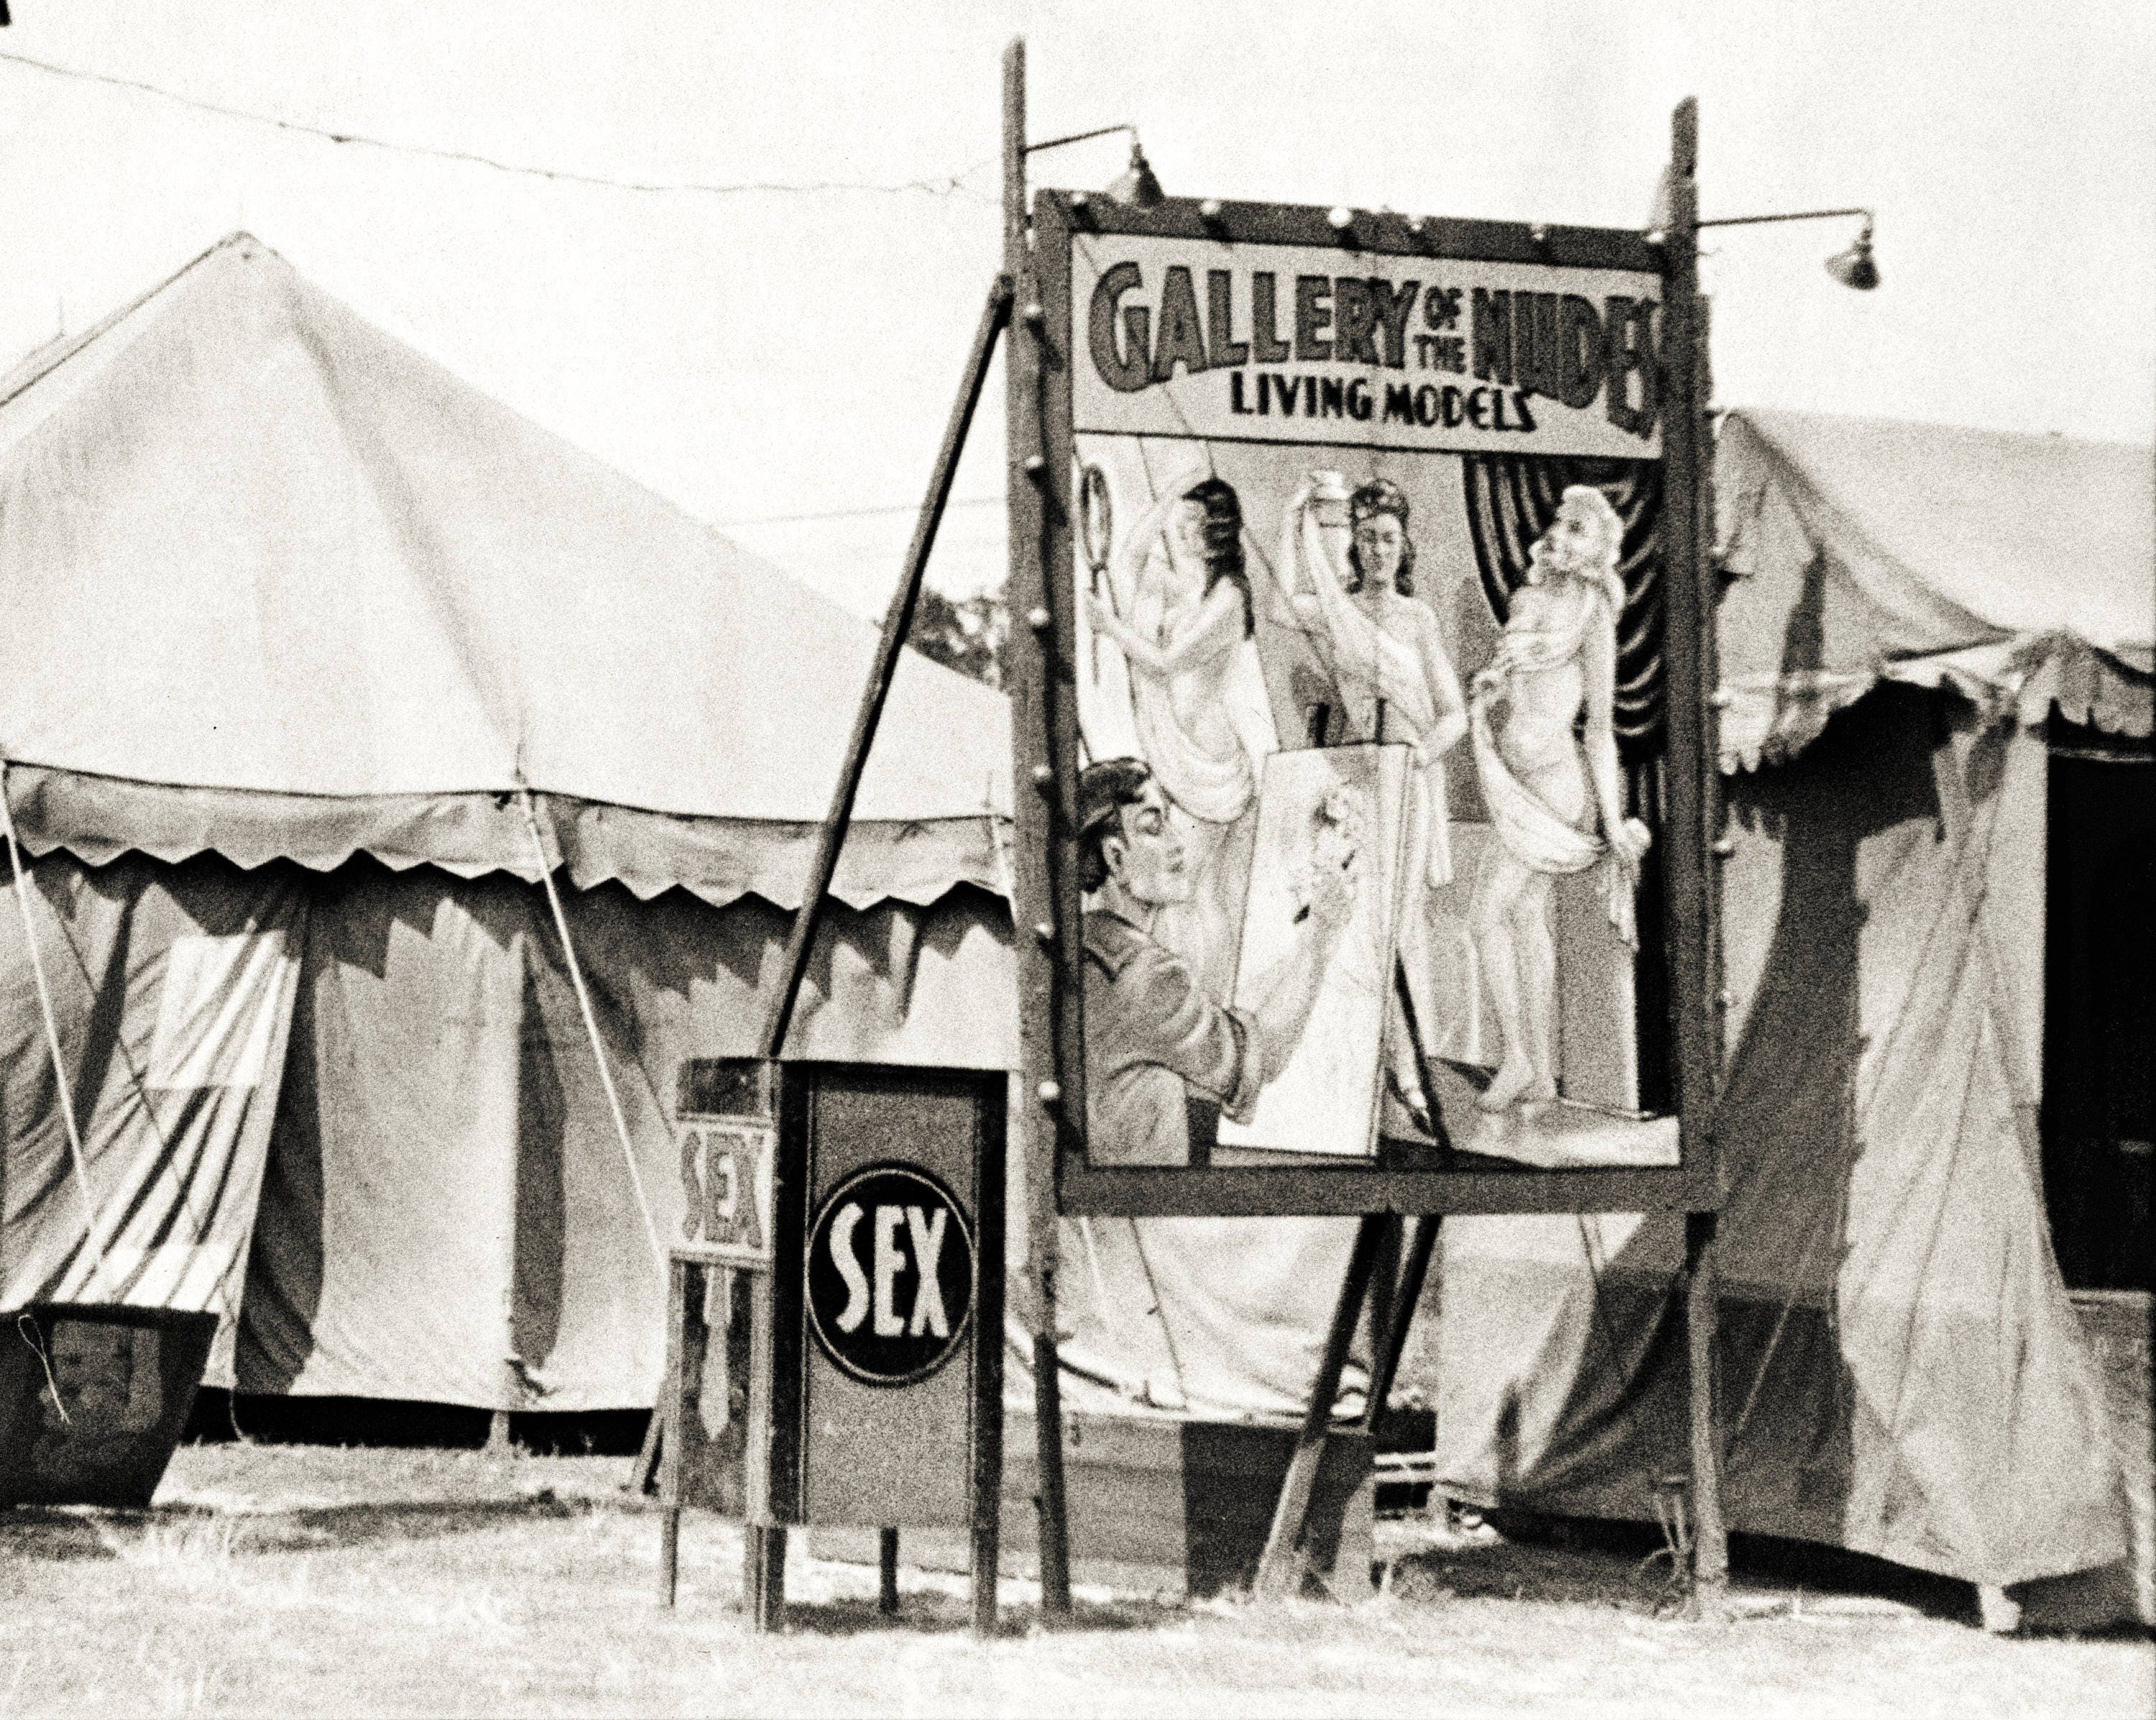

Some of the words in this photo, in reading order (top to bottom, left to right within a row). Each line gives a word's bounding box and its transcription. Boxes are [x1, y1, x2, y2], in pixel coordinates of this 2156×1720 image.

[1087, 260, 1422, 392] GALLERY
[1424, 287, 1463, 330] OF
[1412, 333, 1467, 374] THE
[1230, 371, 1372, 422] LIVING
[1383, 382, 1537, 433] MODELS
[829, 1201, 949, 1338] SEX
